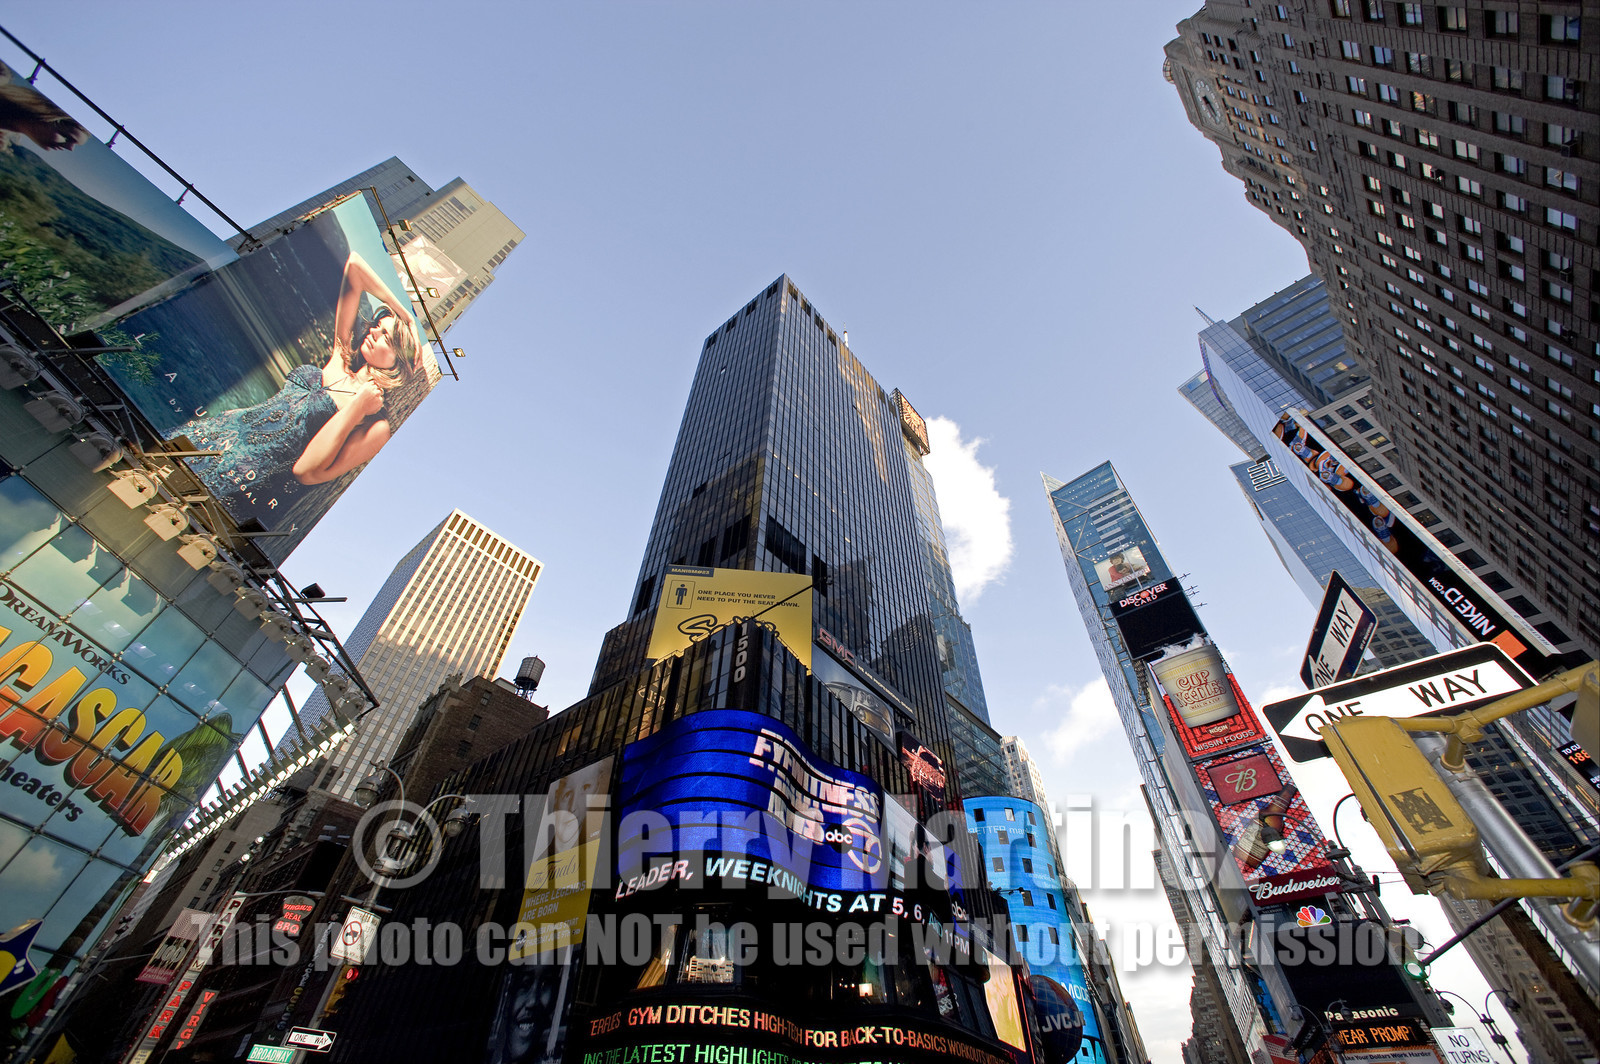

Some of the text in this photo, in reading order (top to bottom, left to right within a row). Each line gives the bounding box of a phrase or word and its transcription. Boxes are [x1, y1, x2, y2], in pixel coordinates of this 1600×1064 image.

[168, 398, 183, 414] by
[228, 469, 259, 506] SEGAL
[1120, 568, 1150, 582] TAYOR
[1119, 582, 1168, 608] DISCOVER
[1134, 594, 1158, 607] CARD
[1329, 600, 1356, 649] WAY
[733, 621, 749, 683] 1500
[819, 627, 856, 667] GMC
[1176, 669, 1210, 690] CUP
[1408, 668, 1488, 708] WAY
[1173, 679, 1227, 708] NOODLES
[0, 625, 183, 837] GASCAR
[1208, 723, 1229, 735] NISSIN
[1193, 729, 1256, 752] NISSIN FOODS
[825, 827, 853, 846] abc
[525, 880, 586, 909] WHERE LEGENDS
[615, 858, 693, 903] LEADER,
[705, 856, 843, 914] WEEKNIGHTS
[849, 893, 887, 915] AT
[892, 897, 909, 919] 5,
[913, 903, 926, 925] 6,
[1248, 874, 1341, 900] Budweiser
[283, 912, 302, 922] REAL
[522, 902, 559, 922] ARE BORN
[275, 920, 300, 934] BBQ
[147, 980, 193, 1039] PARK
[1323, 1005, 1400, 1022] Paasonic
[628, 1006, 661, 1027] GYM
[665, 1005, 751, 1029] DITCHES
[804, 1028, 839, 1049] FOR
[840, 1026, 947, 1053] BACK-TO-BASICS
[1041, 1012, 1073, 1033] JVC
[293, 1033, 329, 1045] ONE WAY
[1447, 1034, 1470, 1049] NO
[249, 1047, 292, 1063] BROADWAY
[623, 1044, 691, 1064] LATEST
[1448, 1049, 1491, 1064] TURNS
